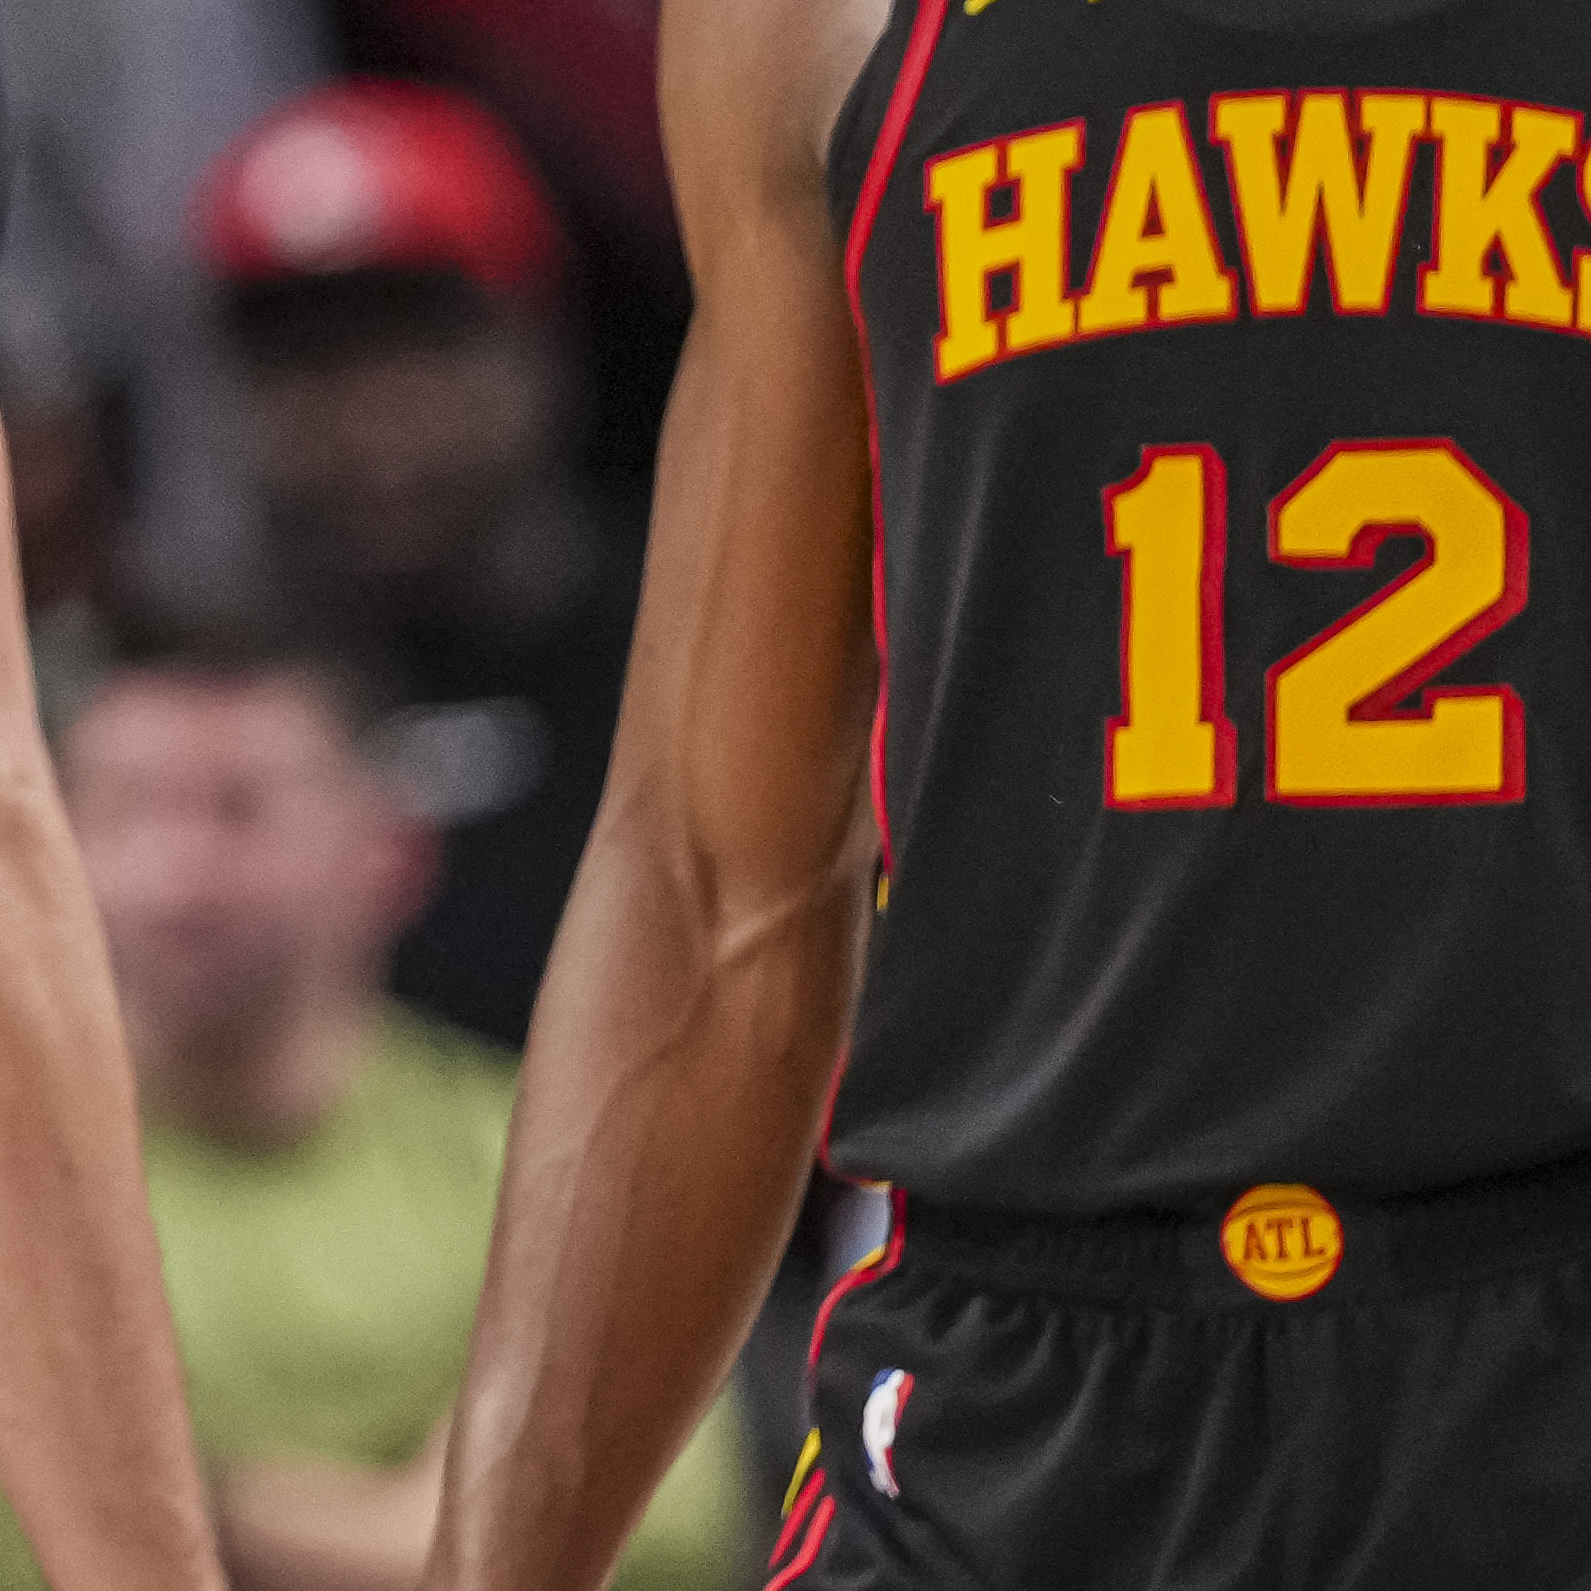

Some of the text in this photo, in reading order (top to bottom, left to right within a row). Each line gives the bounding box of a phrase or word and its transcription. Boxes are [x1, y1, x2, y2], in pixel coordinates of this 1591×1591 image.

[924, 87, 1591, 385] HAWK
[1102, 438, 1530, 808] 12
[1242, 1216, 1329, 1261] ATL
